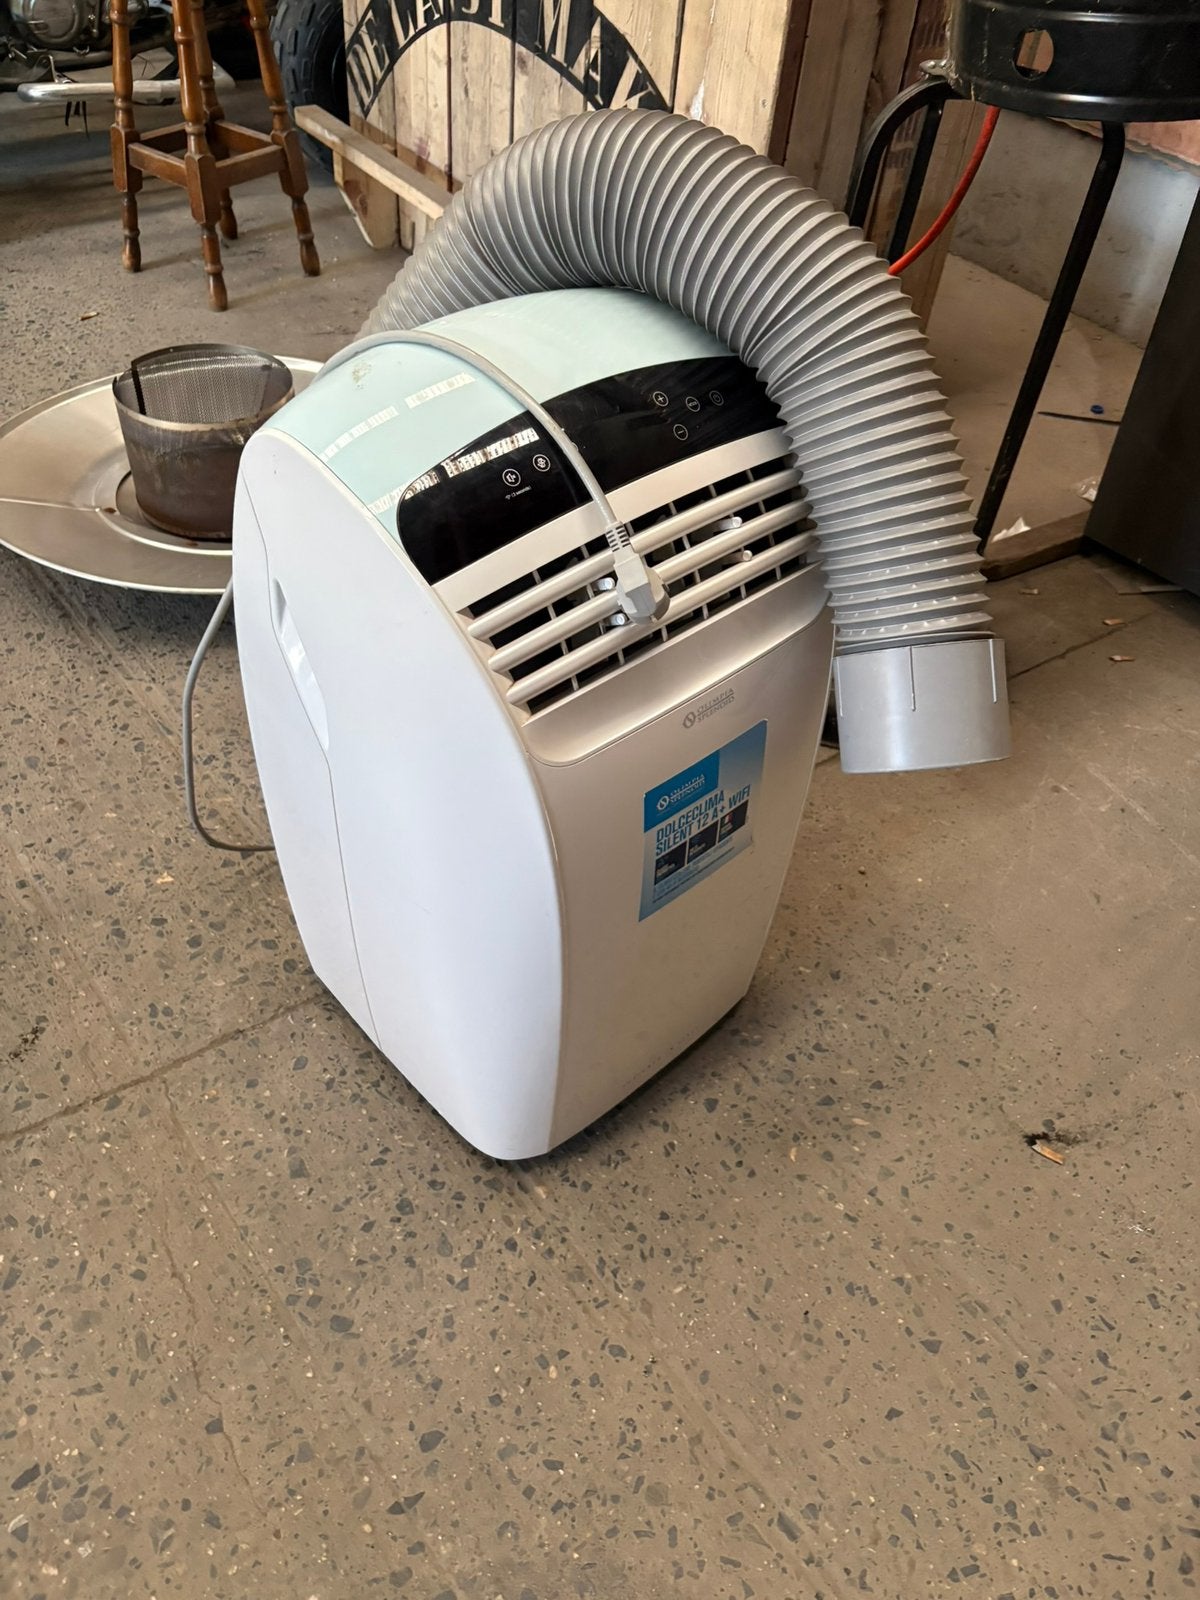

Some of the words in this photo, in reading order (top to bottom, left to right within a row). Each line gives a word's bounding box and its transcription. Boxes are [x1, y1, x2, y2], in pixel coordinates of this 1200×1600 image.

[656, 790, 725, 842] DOLCECLIMA
[656, 822, 692, 857] SILENT
[697, 813, 710, 831] 12
[712, 804, 726, 821] A+
[729, 784, 751, 809] WIFI
